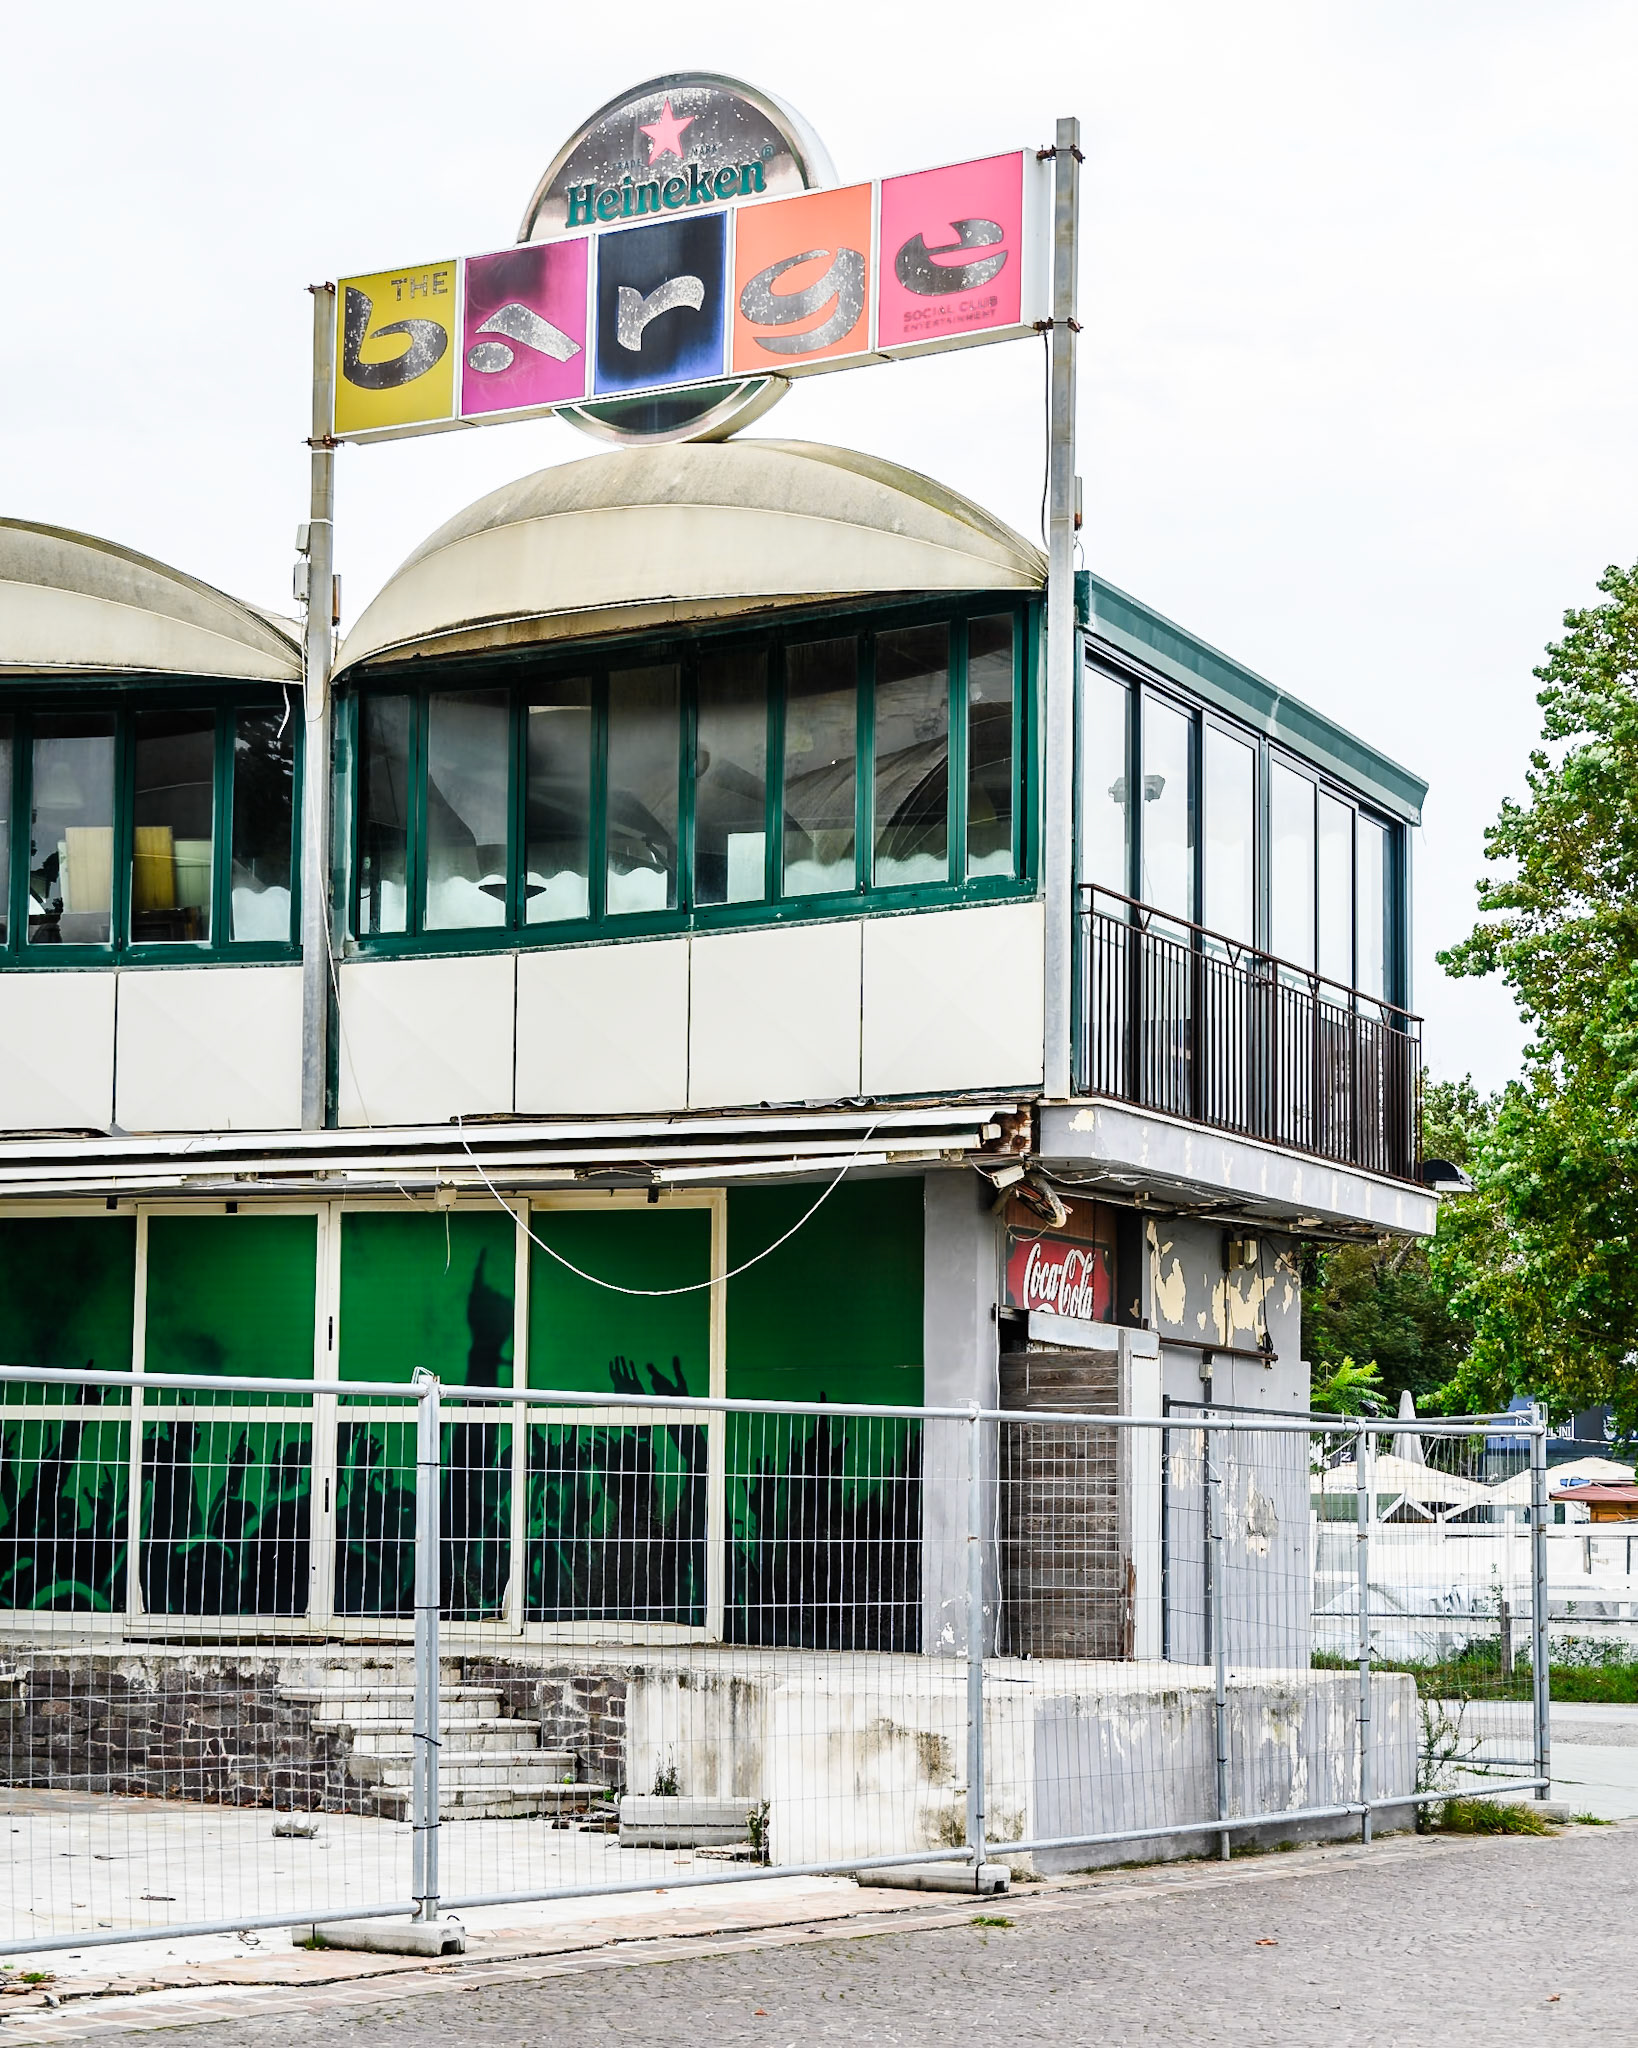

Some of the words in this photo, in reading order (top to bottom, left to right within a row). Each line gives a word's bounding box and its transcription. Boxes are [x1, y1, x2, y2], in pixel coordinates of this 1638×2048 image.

[566, 160, 767, 229] Heineken
[343, 218, 1009, 390] barge
[391, 271, 448, 301] THE
[903, 305, 953, 322] SOCIAL
[960, 296, 998, 312] CLUB
[903, 309, 996, 333] ENTERTAINMENT
[1023, 1243, 1094, 1319] Coca-Cola
